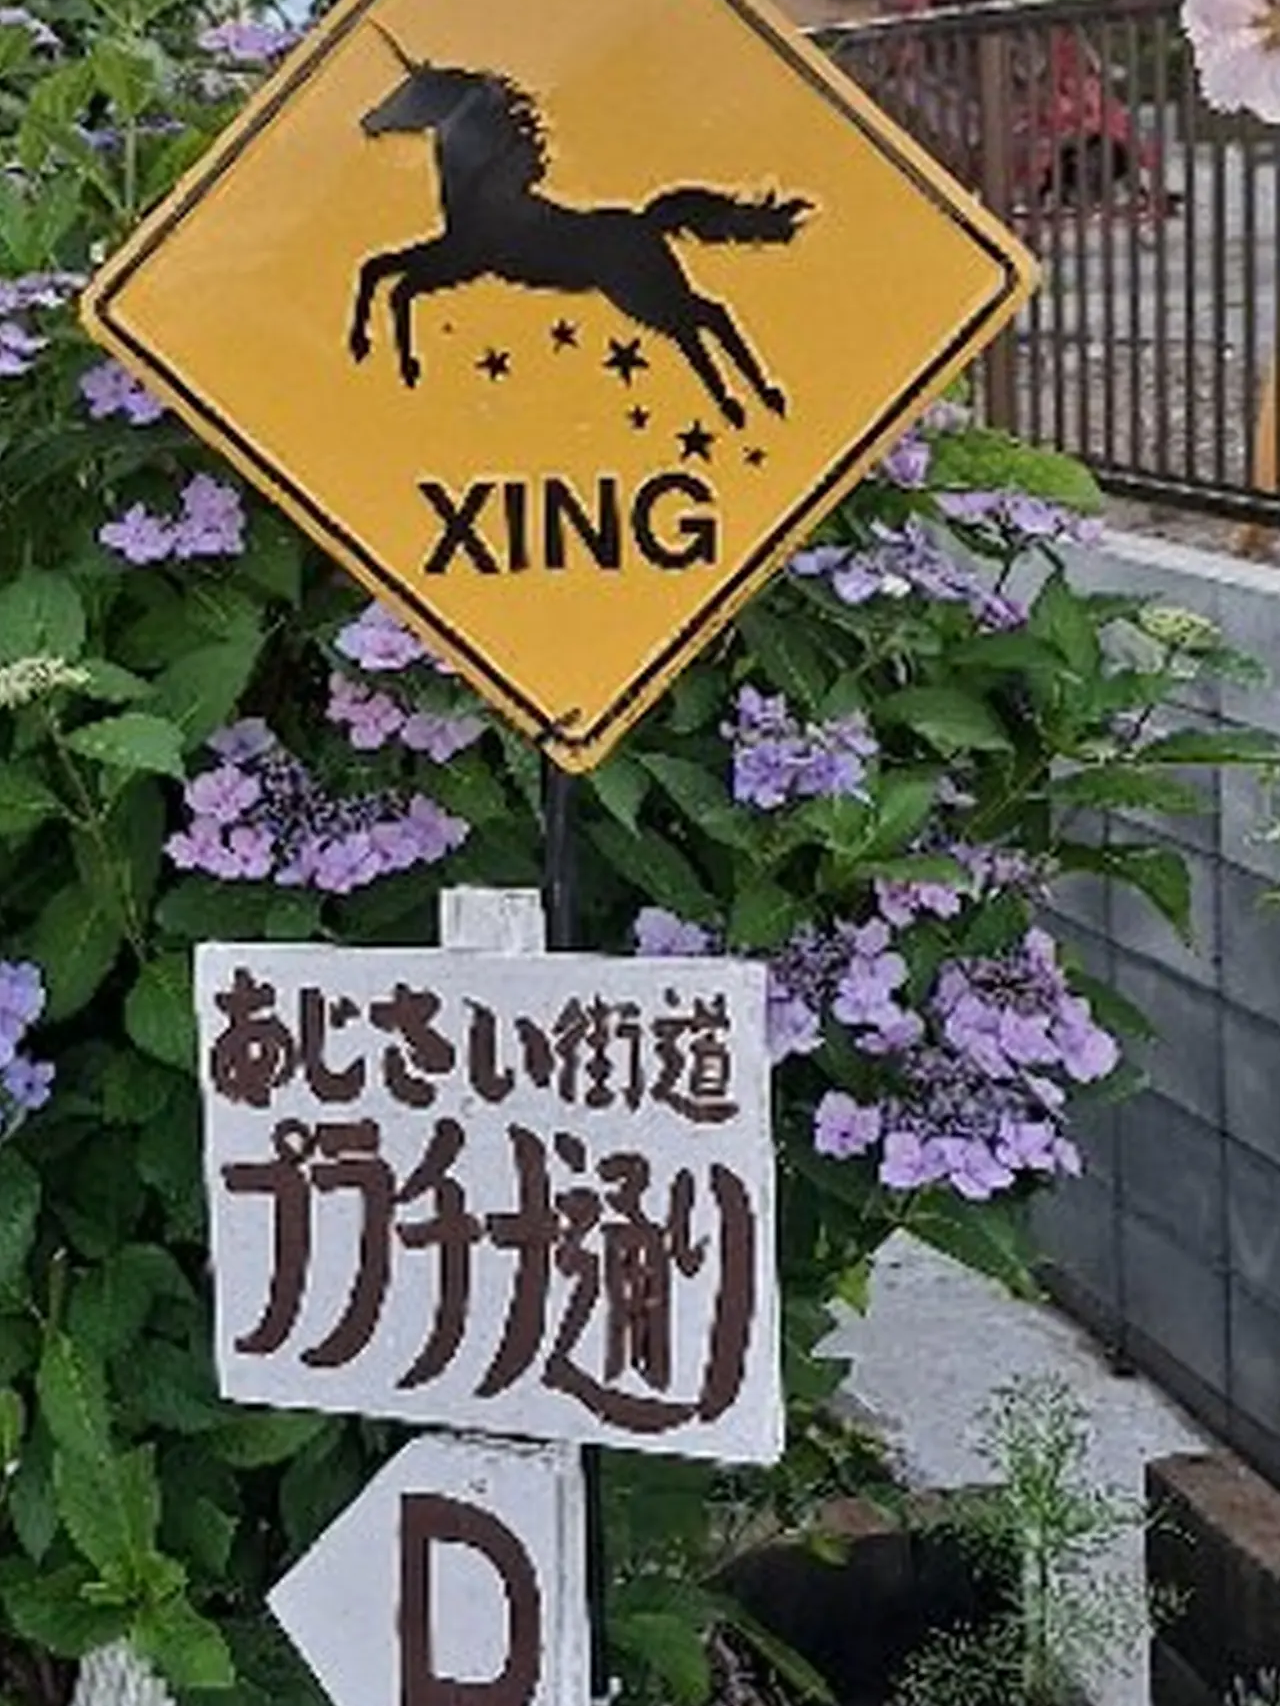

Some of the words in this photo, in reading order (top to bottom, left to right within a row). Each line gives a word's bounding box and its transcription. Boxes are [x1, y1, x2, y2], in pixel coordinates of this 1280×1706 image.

[417, 473, 717, 575] XING
[210, 967, 738, 1122] あじさい街道
[221, 1118, 756, 1434] プラチナ通り
